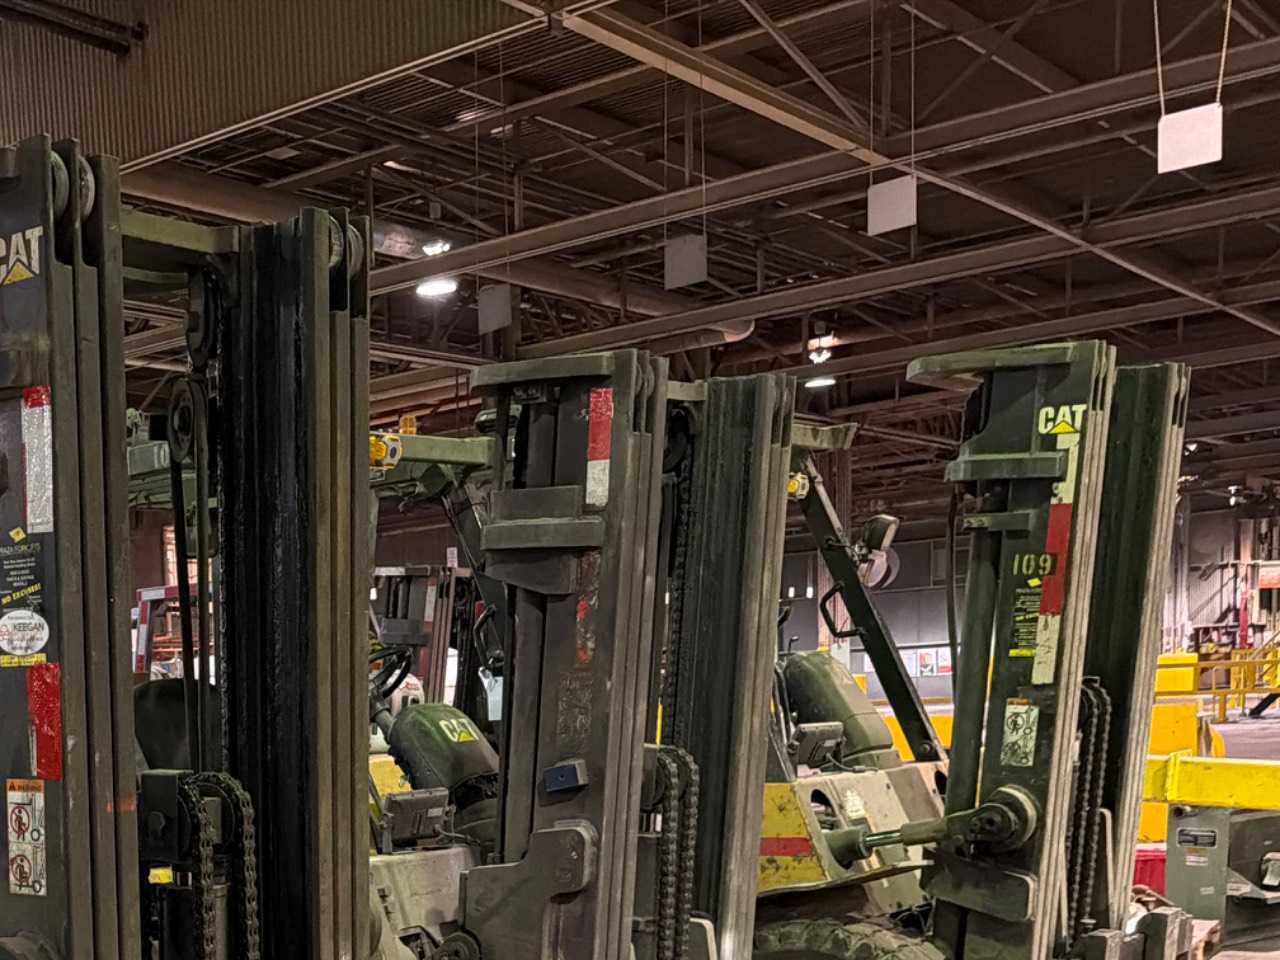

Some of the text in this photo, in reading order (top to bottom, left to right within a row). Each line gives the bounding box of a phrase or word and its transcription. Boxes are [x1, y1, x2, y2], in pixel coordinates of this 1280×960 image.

[1038, 404, 1087, 434] CAT
[1012, 553, 1052, 576] 109
[438, 718, 480, 743] CAT
